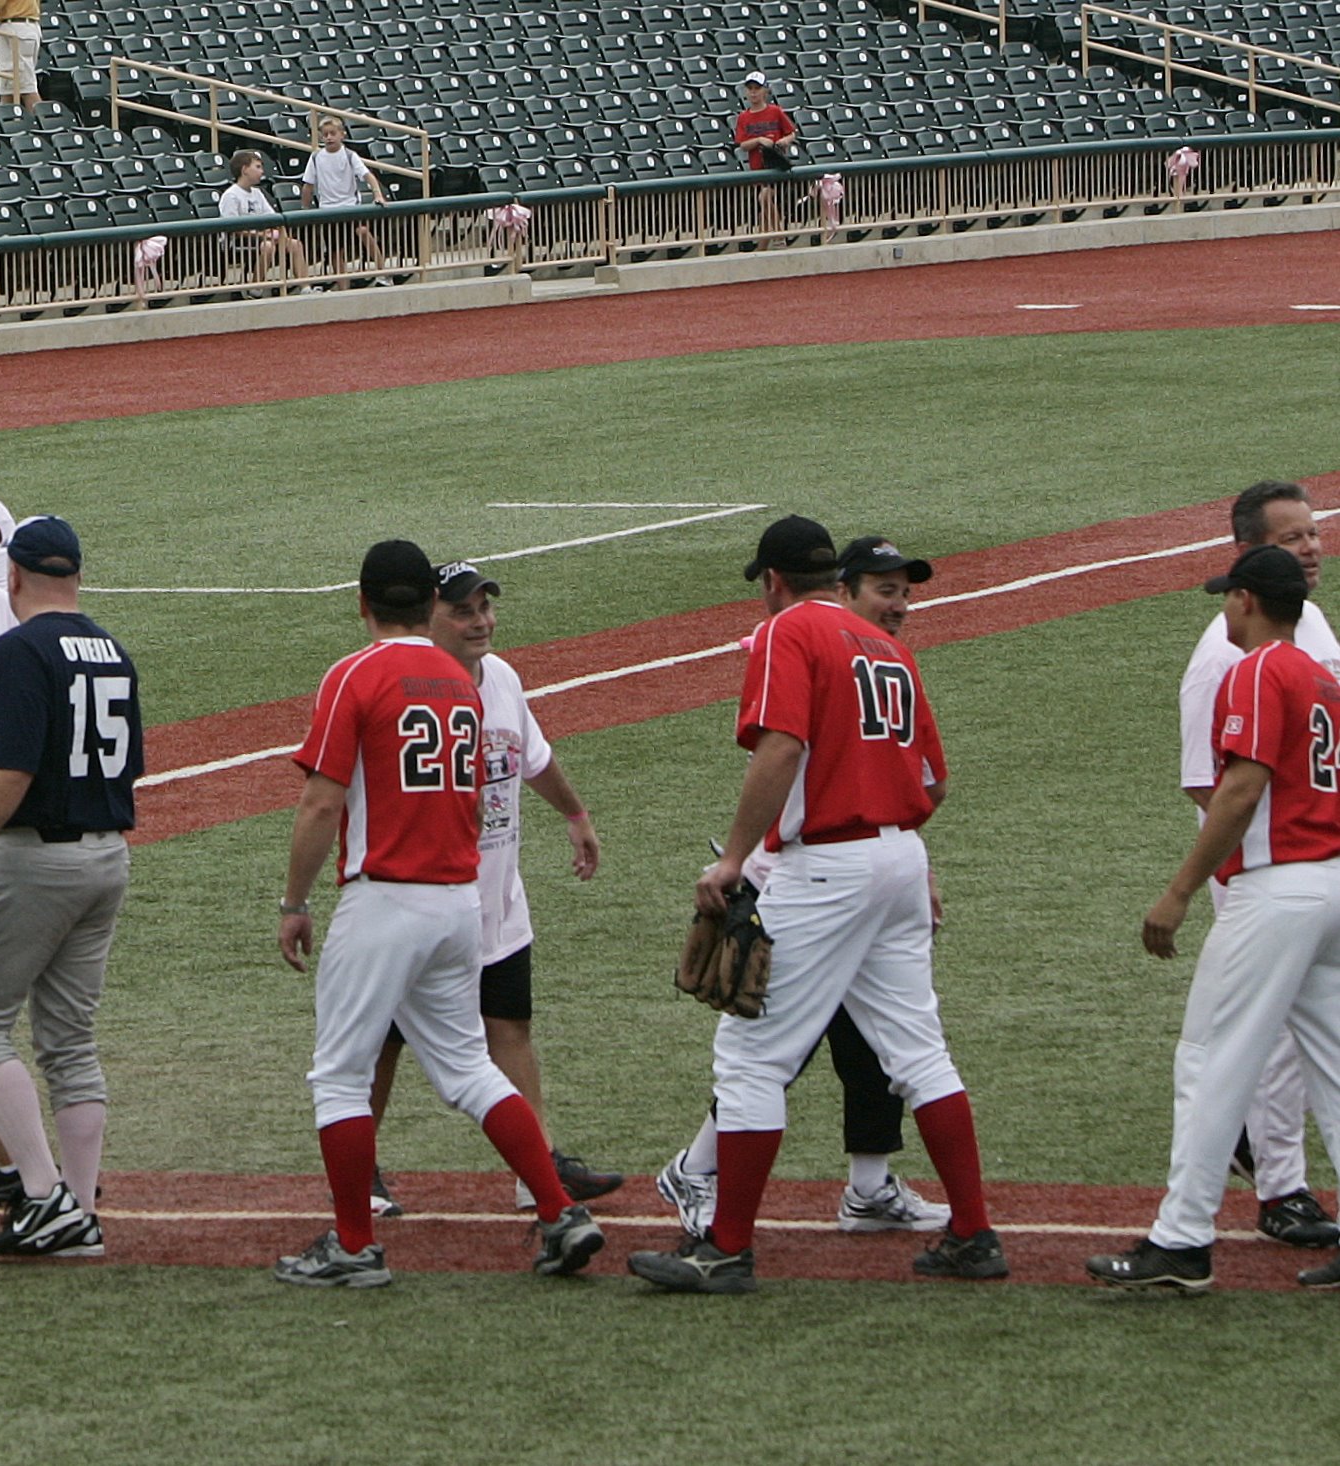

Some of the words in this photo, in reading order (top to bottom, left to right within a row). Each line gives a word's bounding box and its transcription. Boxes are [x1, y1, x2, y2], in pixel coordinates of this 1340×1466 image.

[68, 673, 131, 779] 15
[851, 655, 915, 748] 10
[398, 704, 479, 792] 22
[1309, 703, 1340, 792] 2
